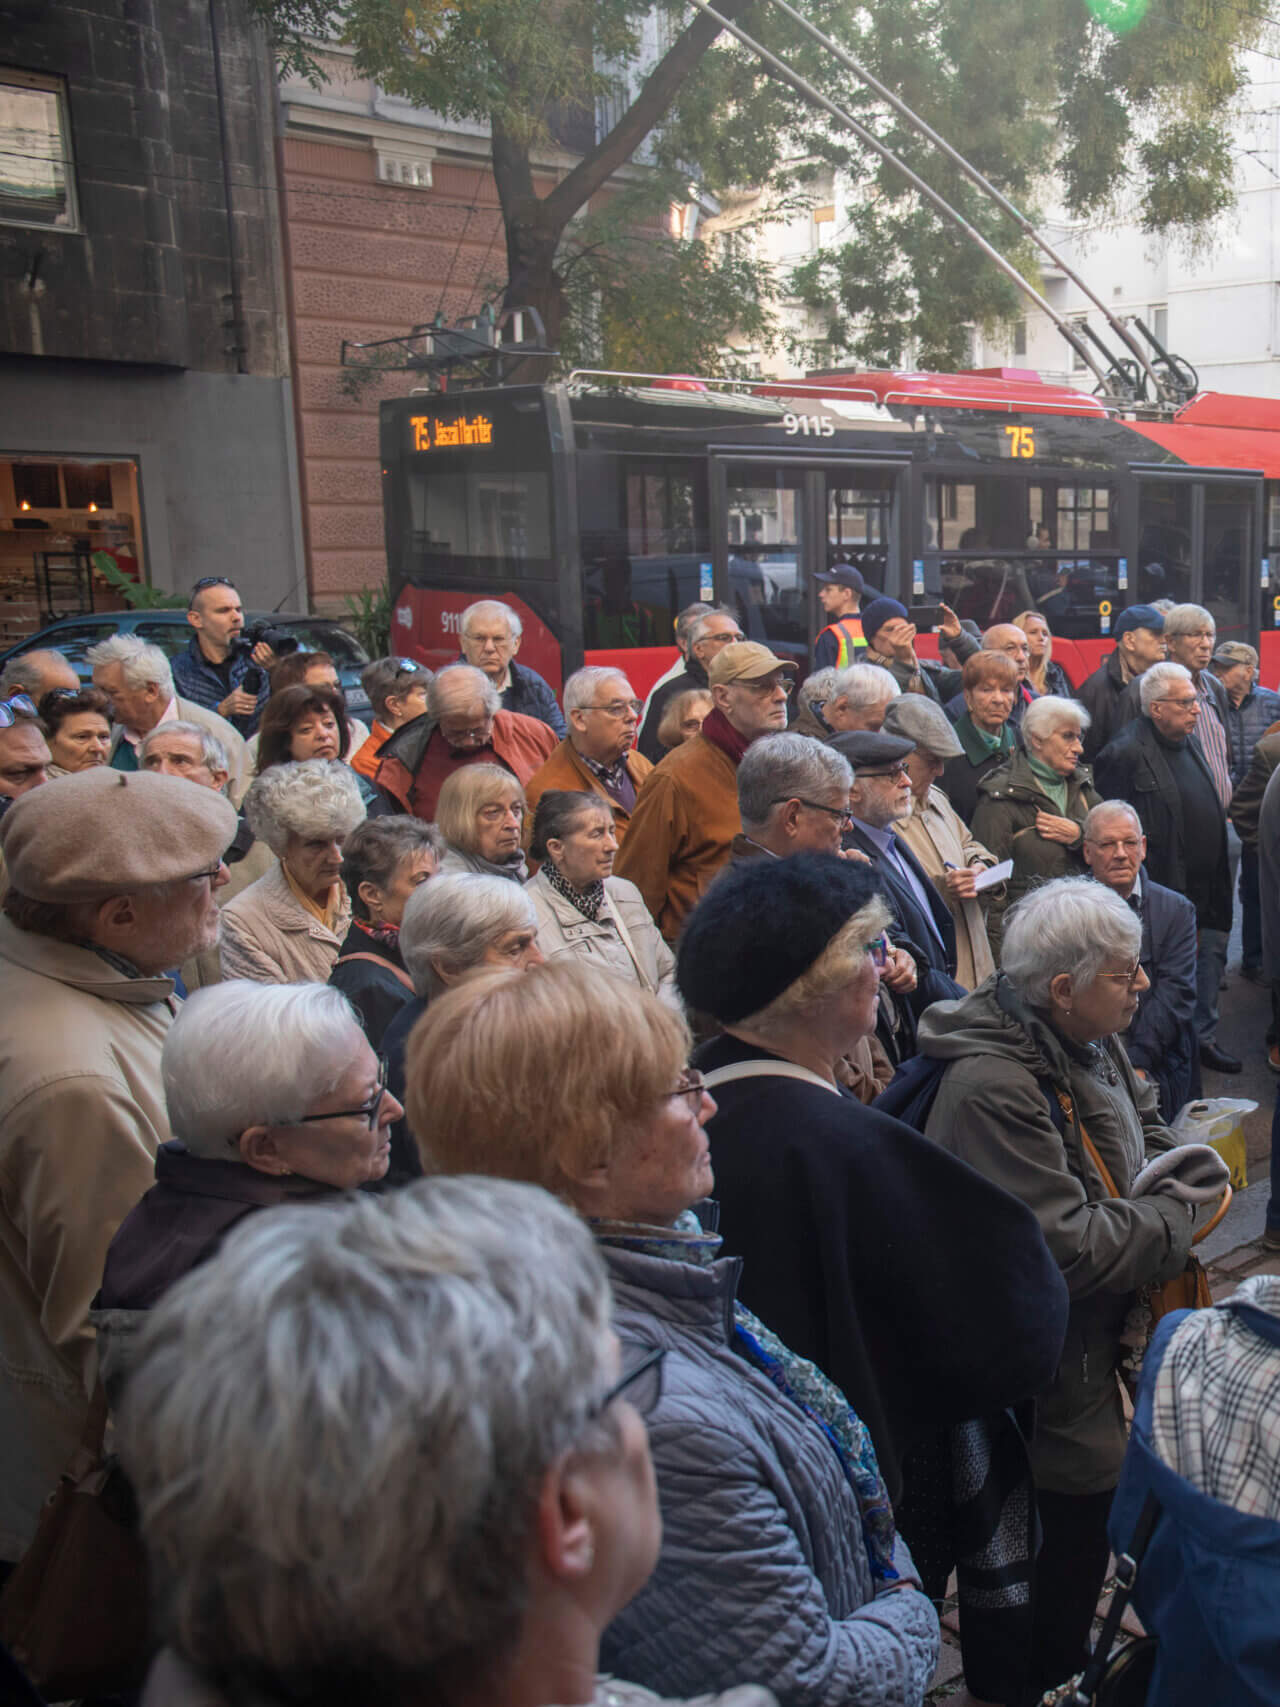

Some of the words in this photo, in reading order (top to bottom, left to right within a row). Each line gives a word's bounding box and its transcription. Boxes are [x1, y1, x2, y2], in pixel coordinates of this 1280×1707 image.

[410, 416, 430, 451] 75
[784, 414, 835, 437] 9115
[1005, 426, 1035, 458] 75
[441, 611, 464, 632] 911
